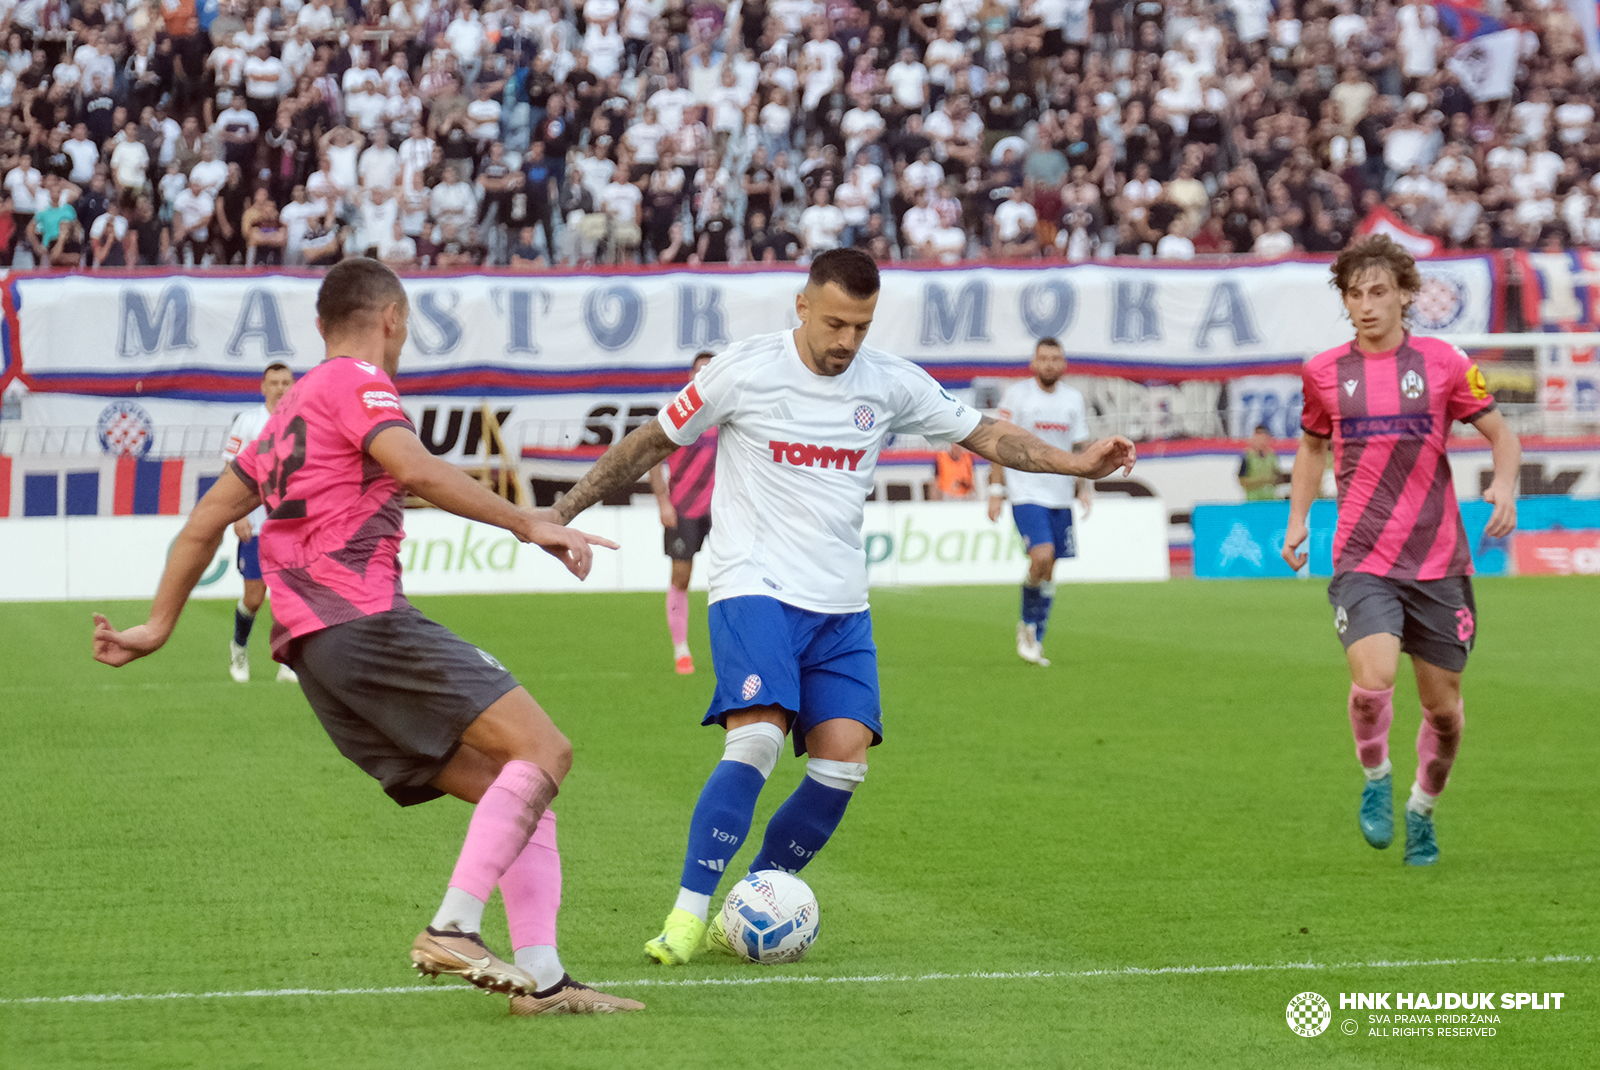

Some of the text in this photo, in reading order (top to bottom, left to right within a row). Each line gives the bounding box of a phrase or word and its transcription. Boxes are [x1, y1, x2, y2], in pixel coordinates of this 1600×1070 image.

[768, 440, 868, 472] TOMMY
[401, 522, 520, 572] anka
[712, 827, 739, 846] 1911
